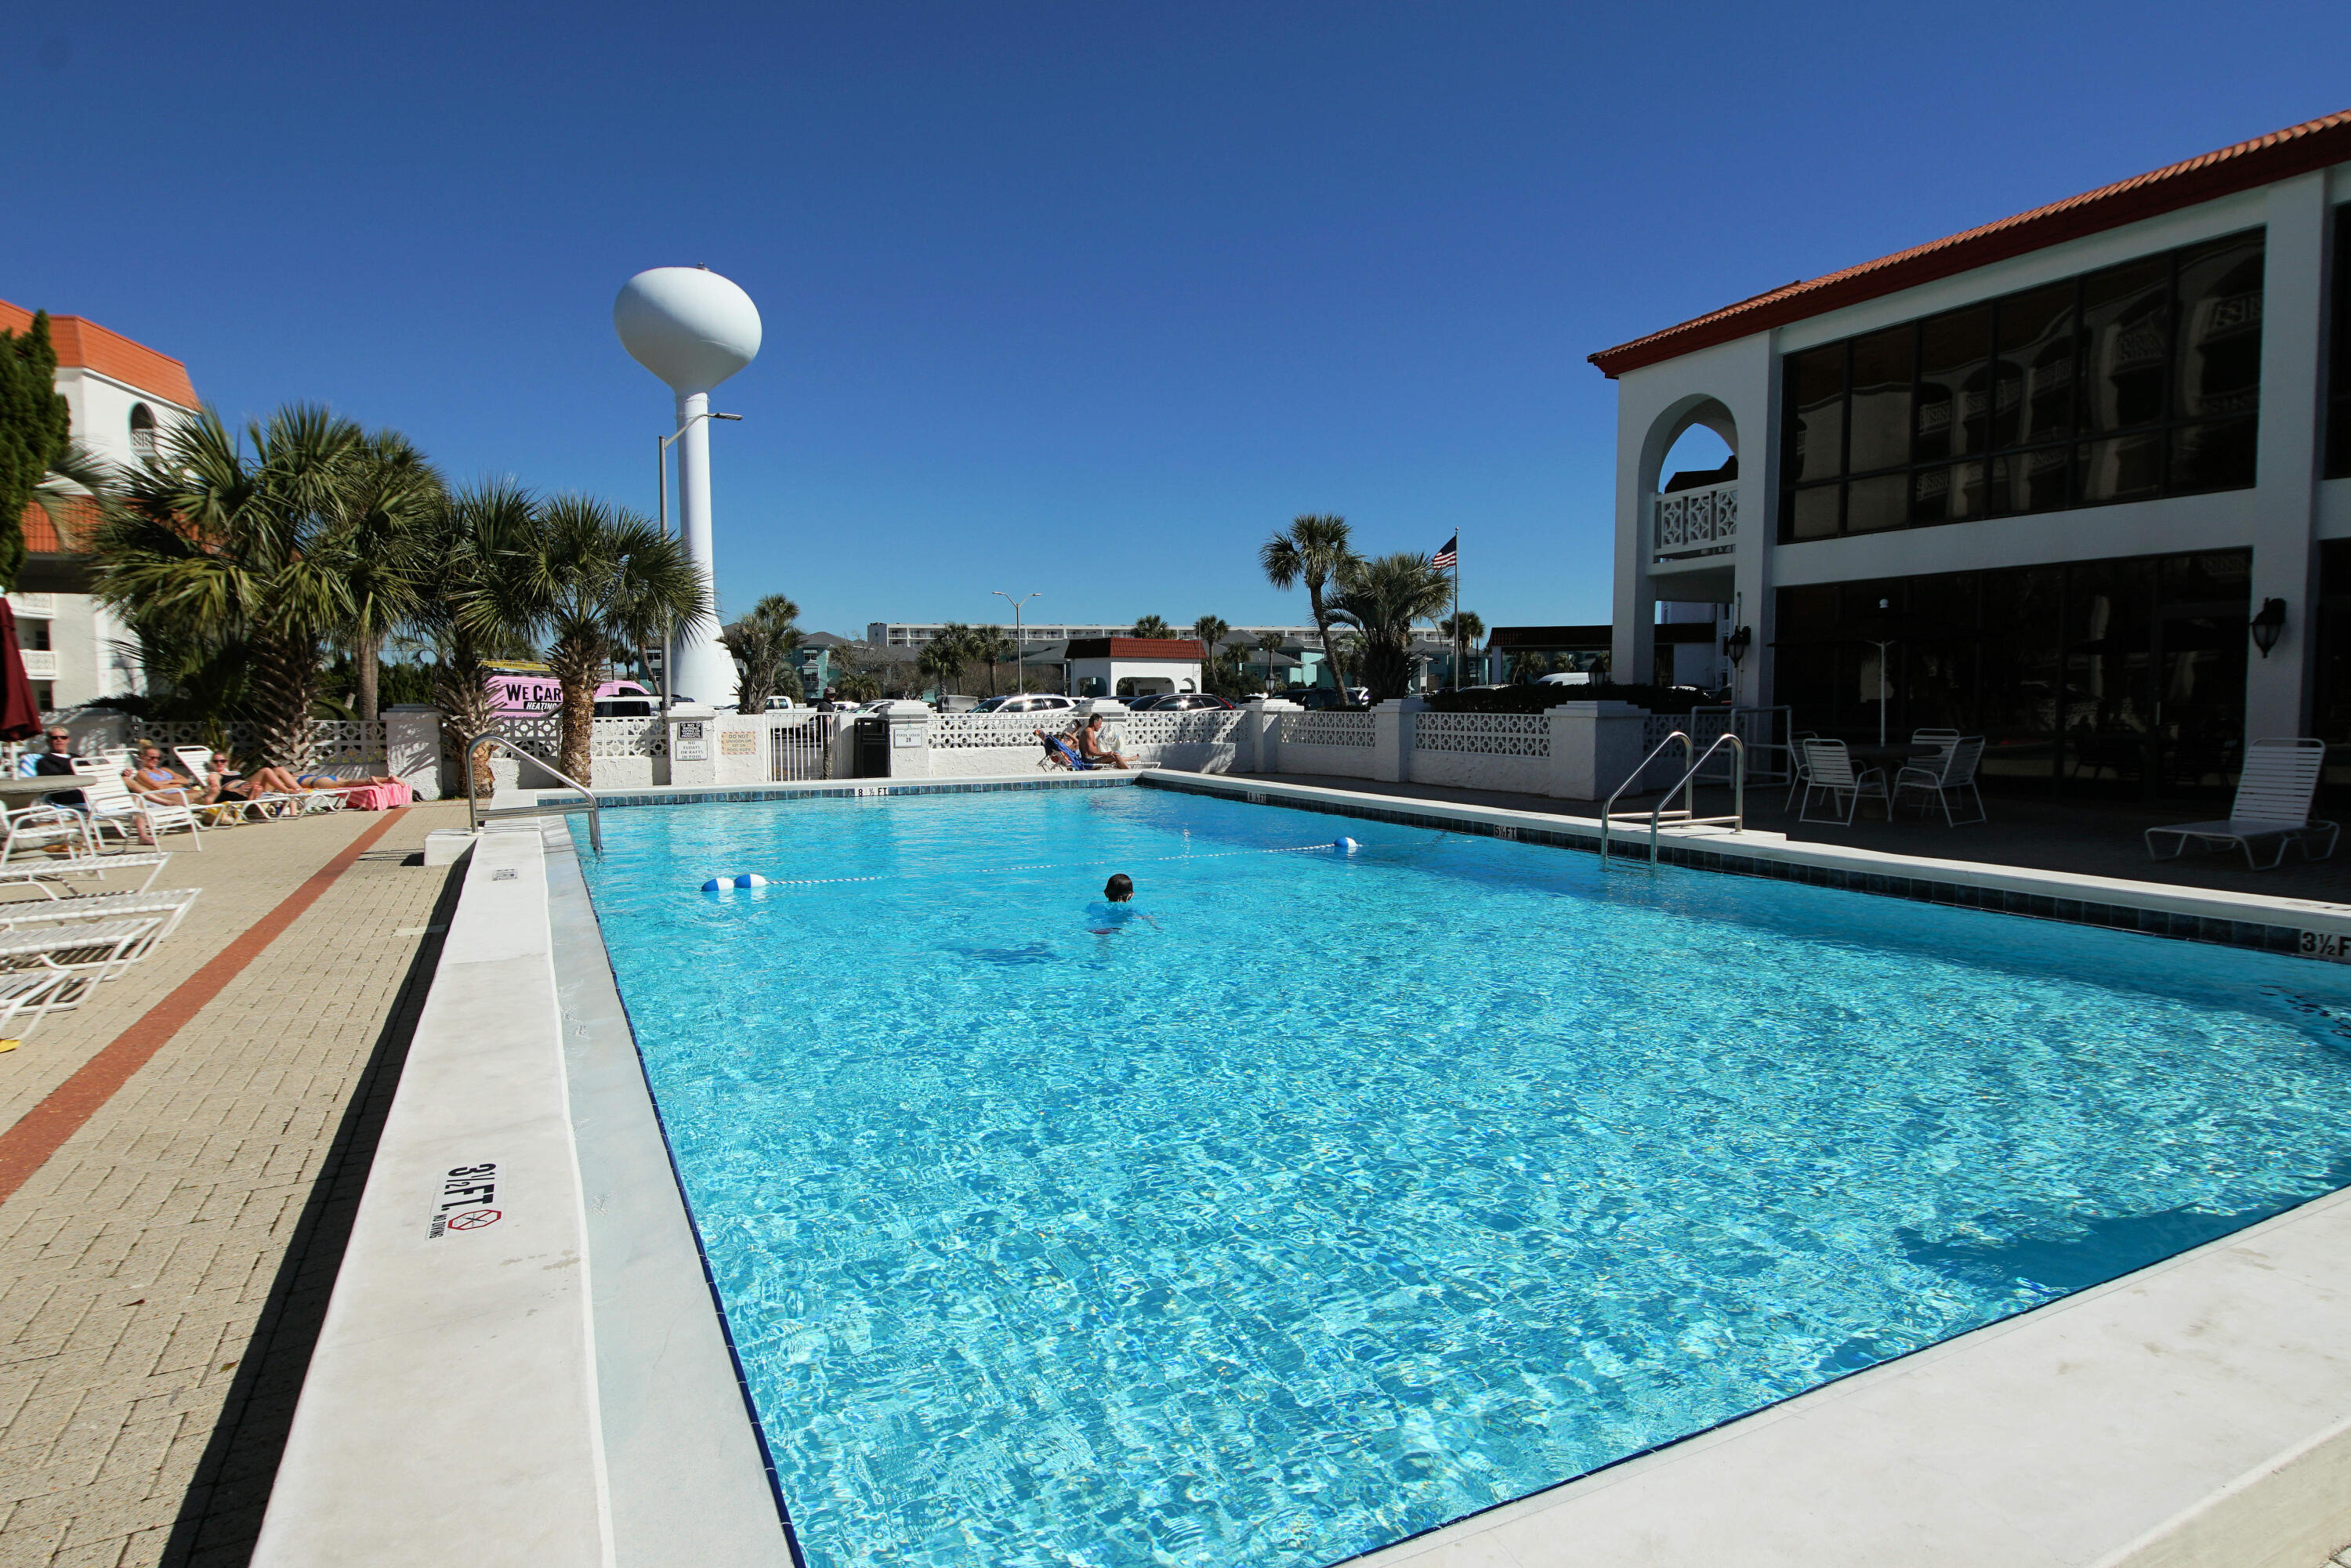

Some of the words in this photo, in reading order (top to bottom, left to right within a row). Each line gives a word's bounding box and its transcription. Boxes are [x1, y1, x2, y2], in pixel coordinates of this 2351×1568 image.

[505, 683, 529, 701] WE
[858, 788, 863, 797] 8
[429, 1222, 446, 1239] DIVING
